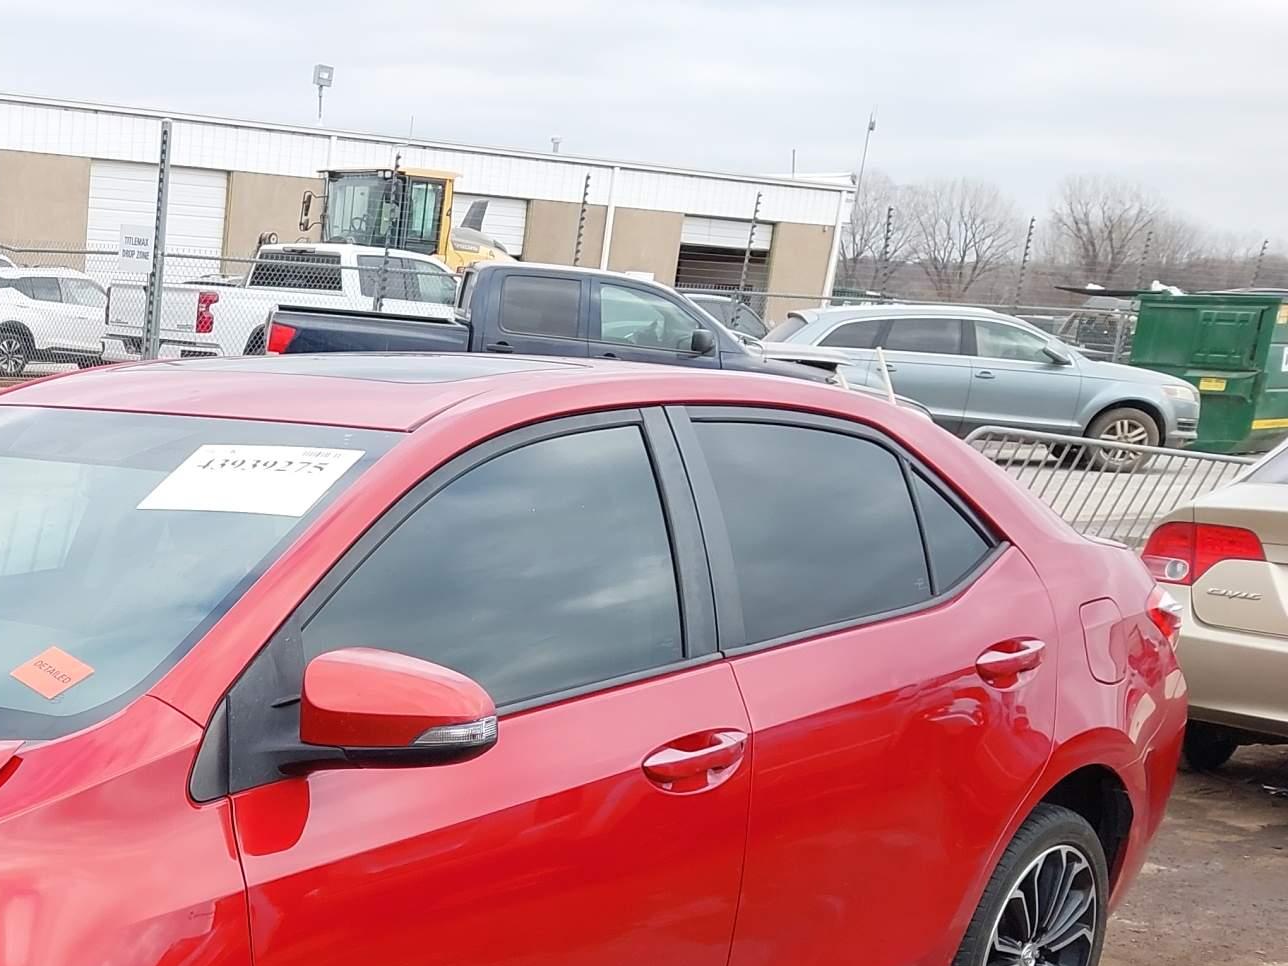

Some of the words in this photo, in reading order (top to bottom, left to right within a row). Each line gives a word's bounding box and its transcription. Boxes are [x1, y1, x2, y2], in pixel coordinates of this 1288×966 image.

[124, 236, 149, 246] TITLEMAX
[122, 249, 135, 258] DROP
[136, 250, 150, 260] ZONE
[197, 458, 330, 474] 43939275
[33, 660, 72, 684] DETAILED
